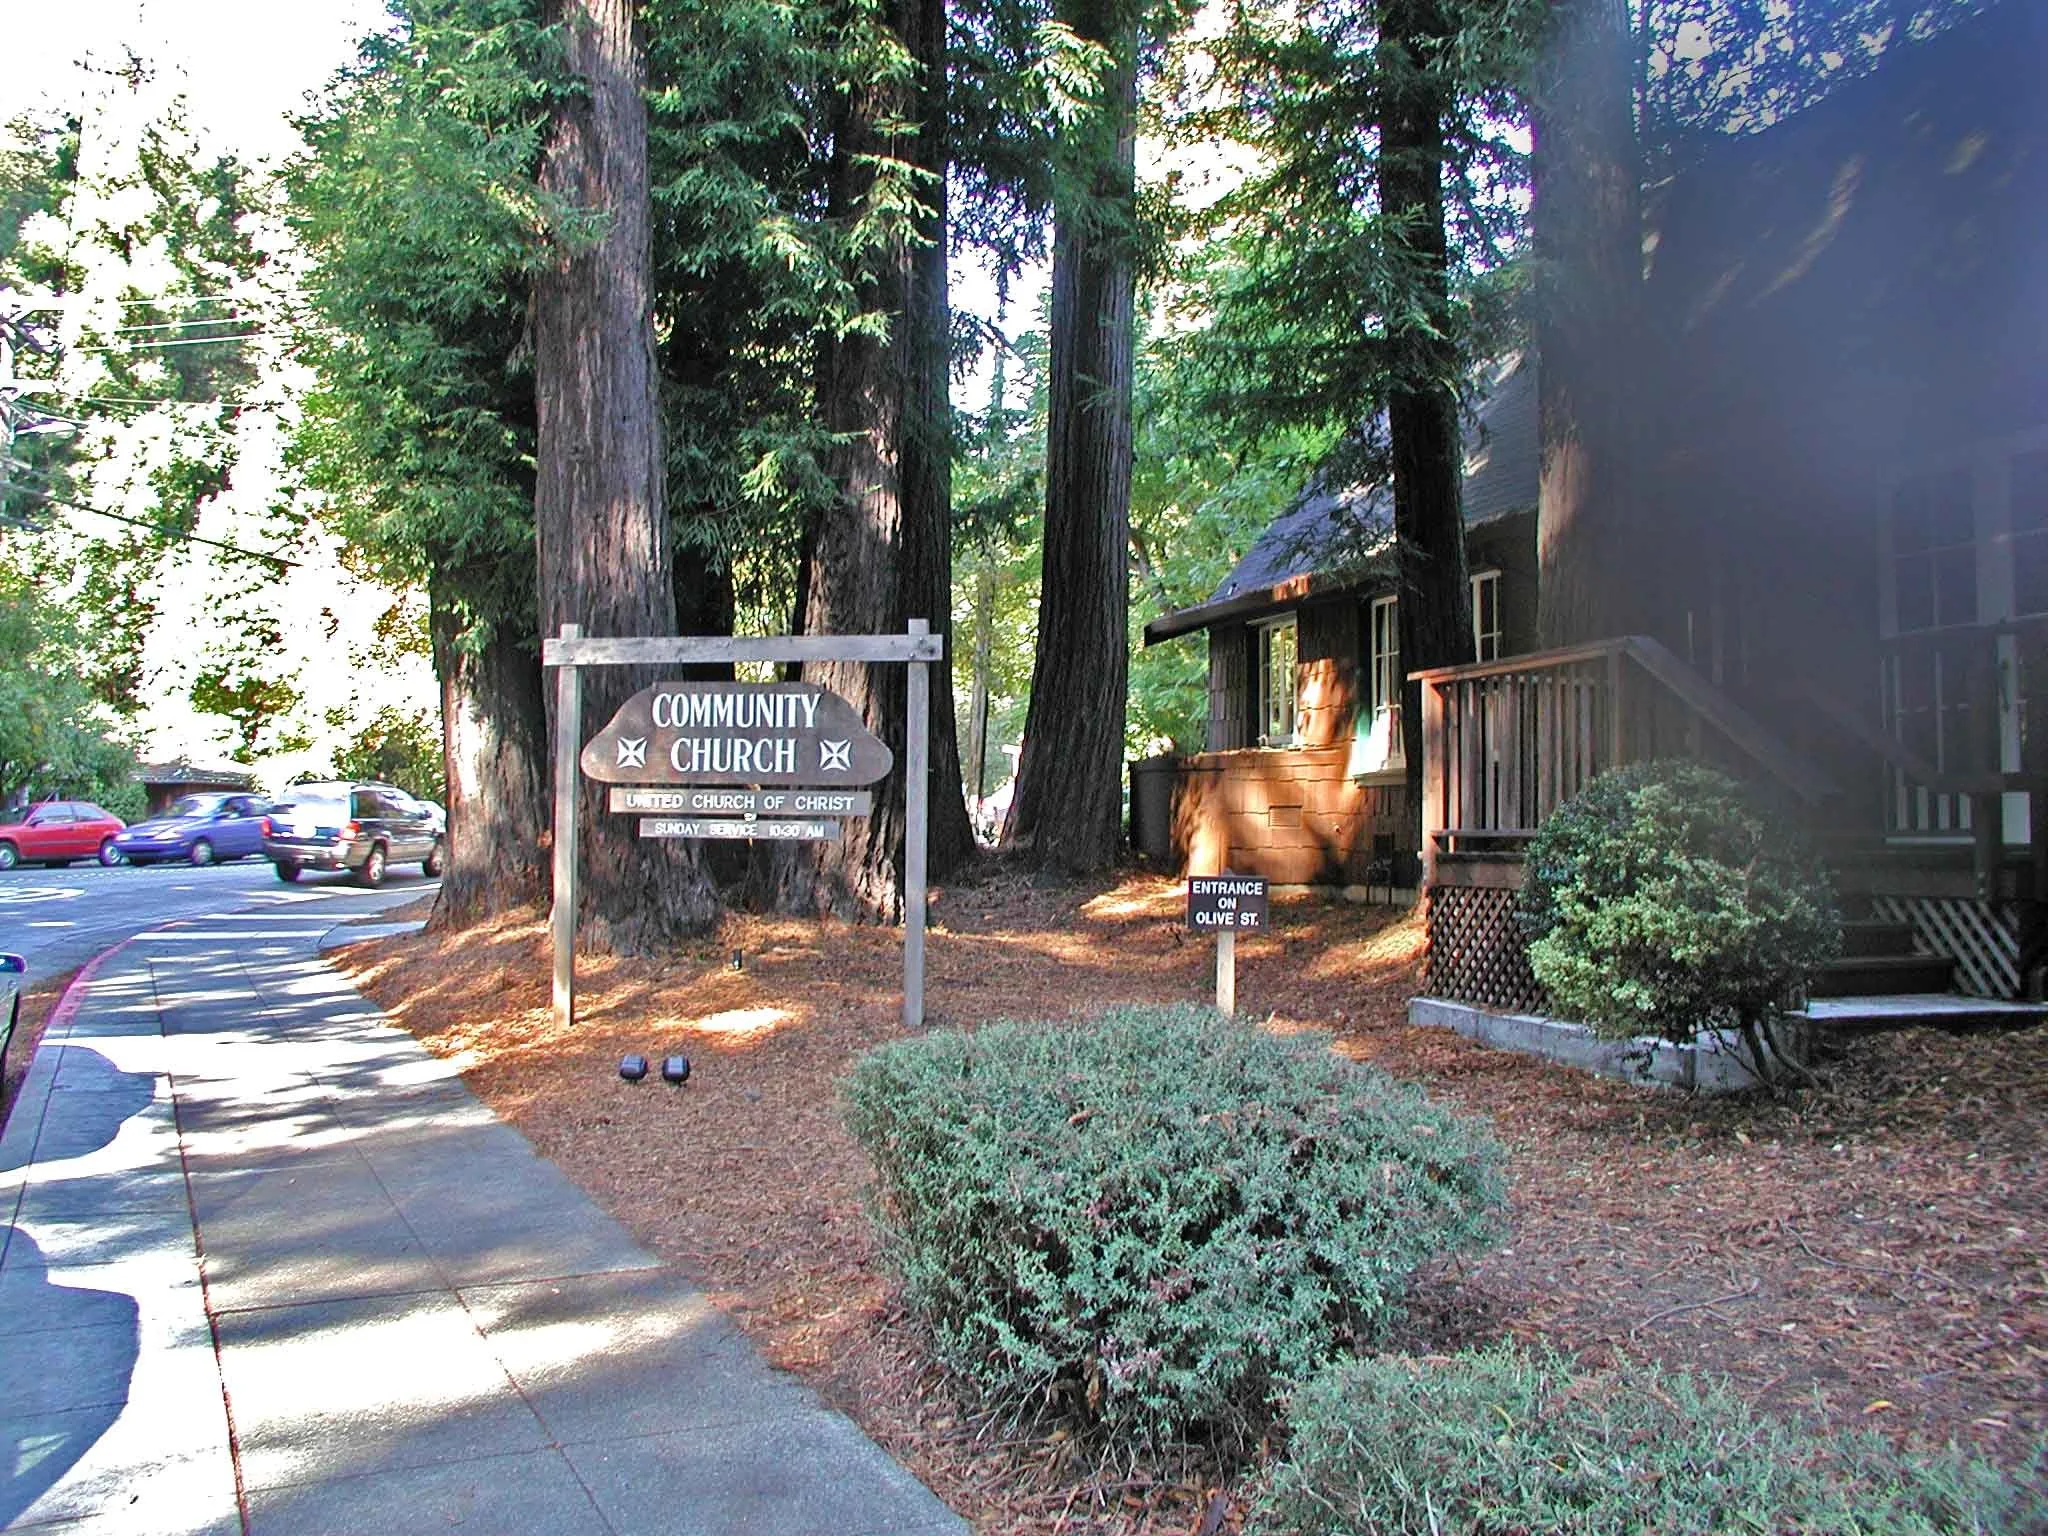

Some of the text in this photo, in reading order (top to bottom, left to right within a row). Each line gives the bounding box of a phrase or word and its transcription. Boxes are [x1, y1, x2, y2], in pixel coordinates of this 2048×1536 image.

[652, 692, 824, 729] COMMUNITY
[670, 737, 797, 774] CHURCH
[626, 793, 855, 811] UNITED CHURCH OF CHRIST
[655, 822, 700, 835] SUNDAY
[709, 823, 758, 837] SERVICE
[806, 824, 825, 838] AM
[1192, 881, 1263, 895] ENTRANCE
[1217, 897, 1237, 910] ON
[1195, 911, 1259, 926] OLIVE ST.
